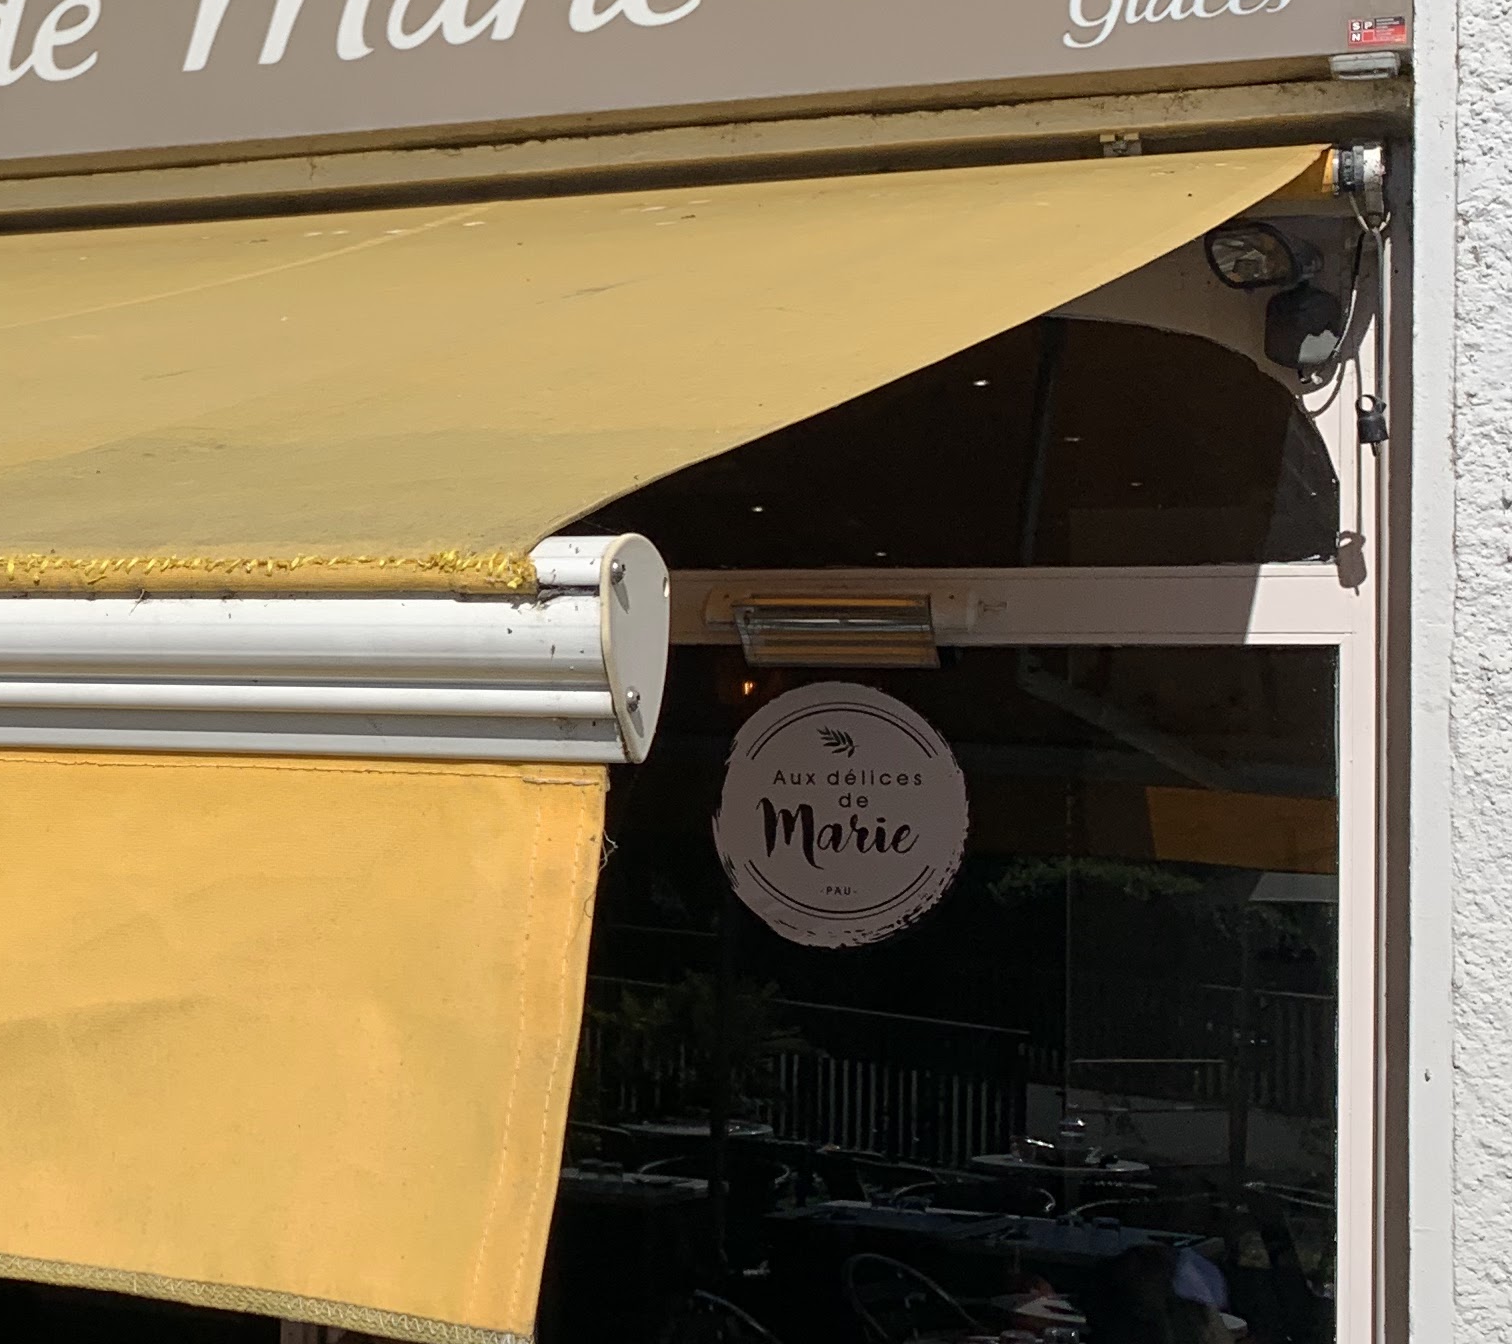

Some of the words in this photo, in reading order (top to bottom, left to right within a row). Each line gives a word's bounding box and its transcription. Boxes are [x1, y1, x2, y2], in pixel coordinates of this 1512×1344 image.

[772, 769, 816, 786] Aux
[826, 768, 923, 786] délices
[838, 792, 869, 808] de
[755, 797, 920, 870] Marie
